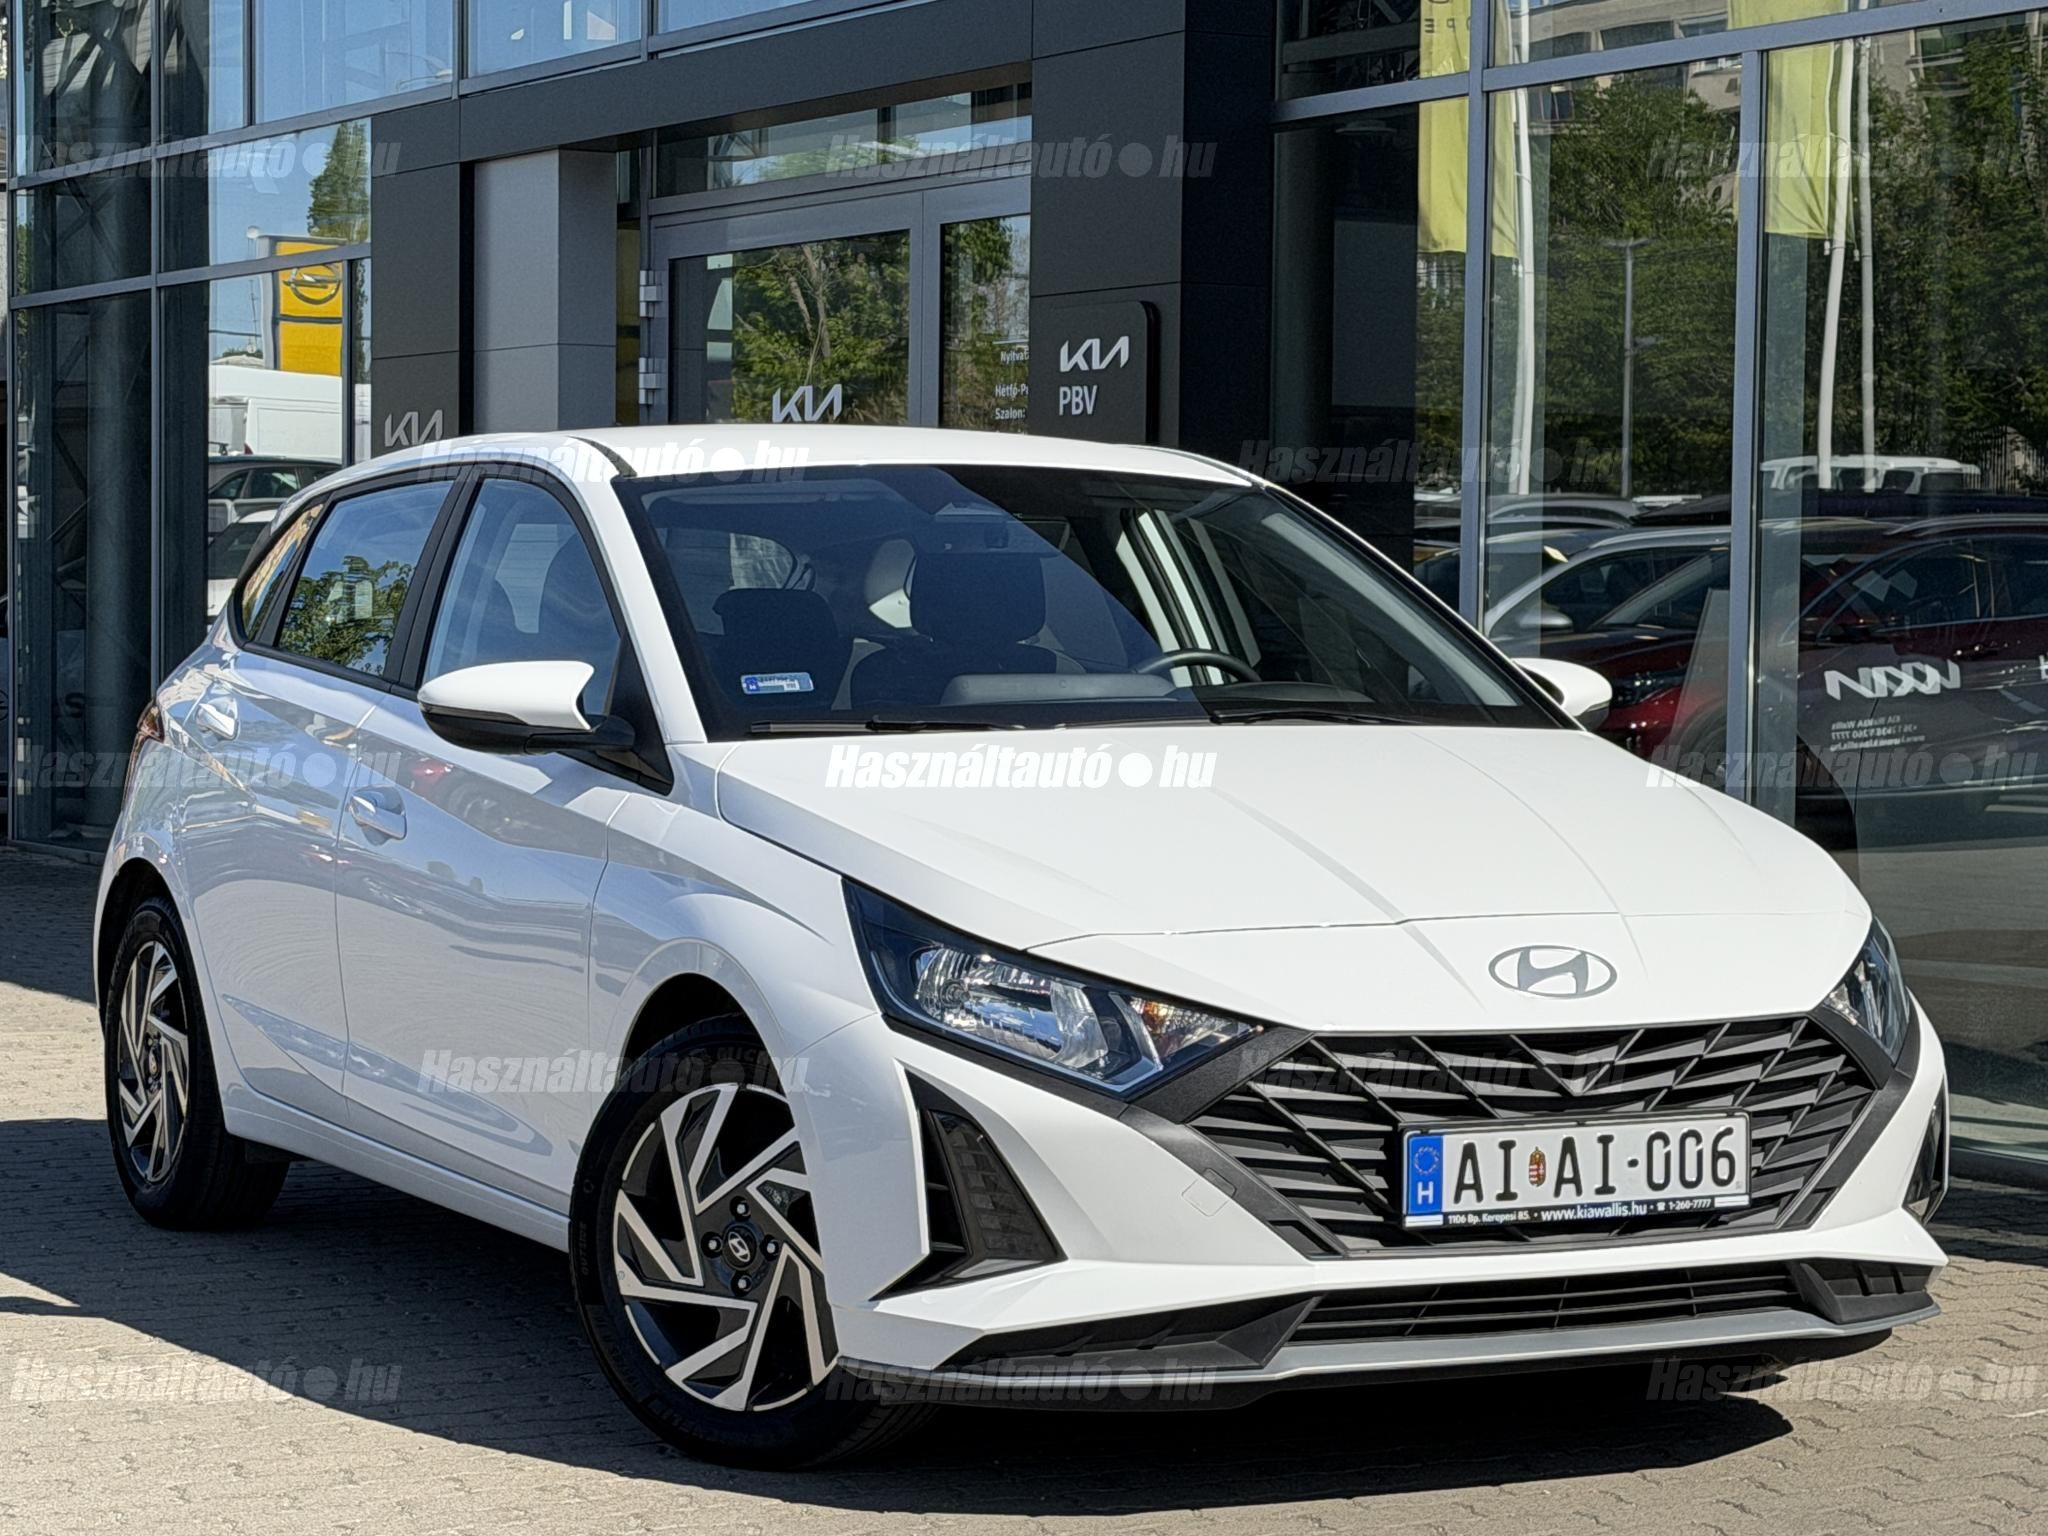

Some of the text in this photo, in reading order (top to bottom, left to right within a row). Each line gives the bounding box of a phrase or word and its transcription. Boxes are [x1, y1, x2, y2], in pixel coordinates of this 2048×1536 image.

[1060, 336, 1129, 372] KIA
[772, 384, 842, 423] KIA
[1059, 385, 1098, 416] PBV
[385, 409, 443, 447] KIA
[1453, 1127, 1736, 1205] AI AI-006
[1417, 1181, 1434, 1205] H
[1448, 1214, 1467, 1225] 1106
[1468, 1214, 1481, 1225] Bp.
[1482, 1212, 1517, 1224] Kerepesi
[1541, 1200, 1647, 1221] www.kiawallis.hu
